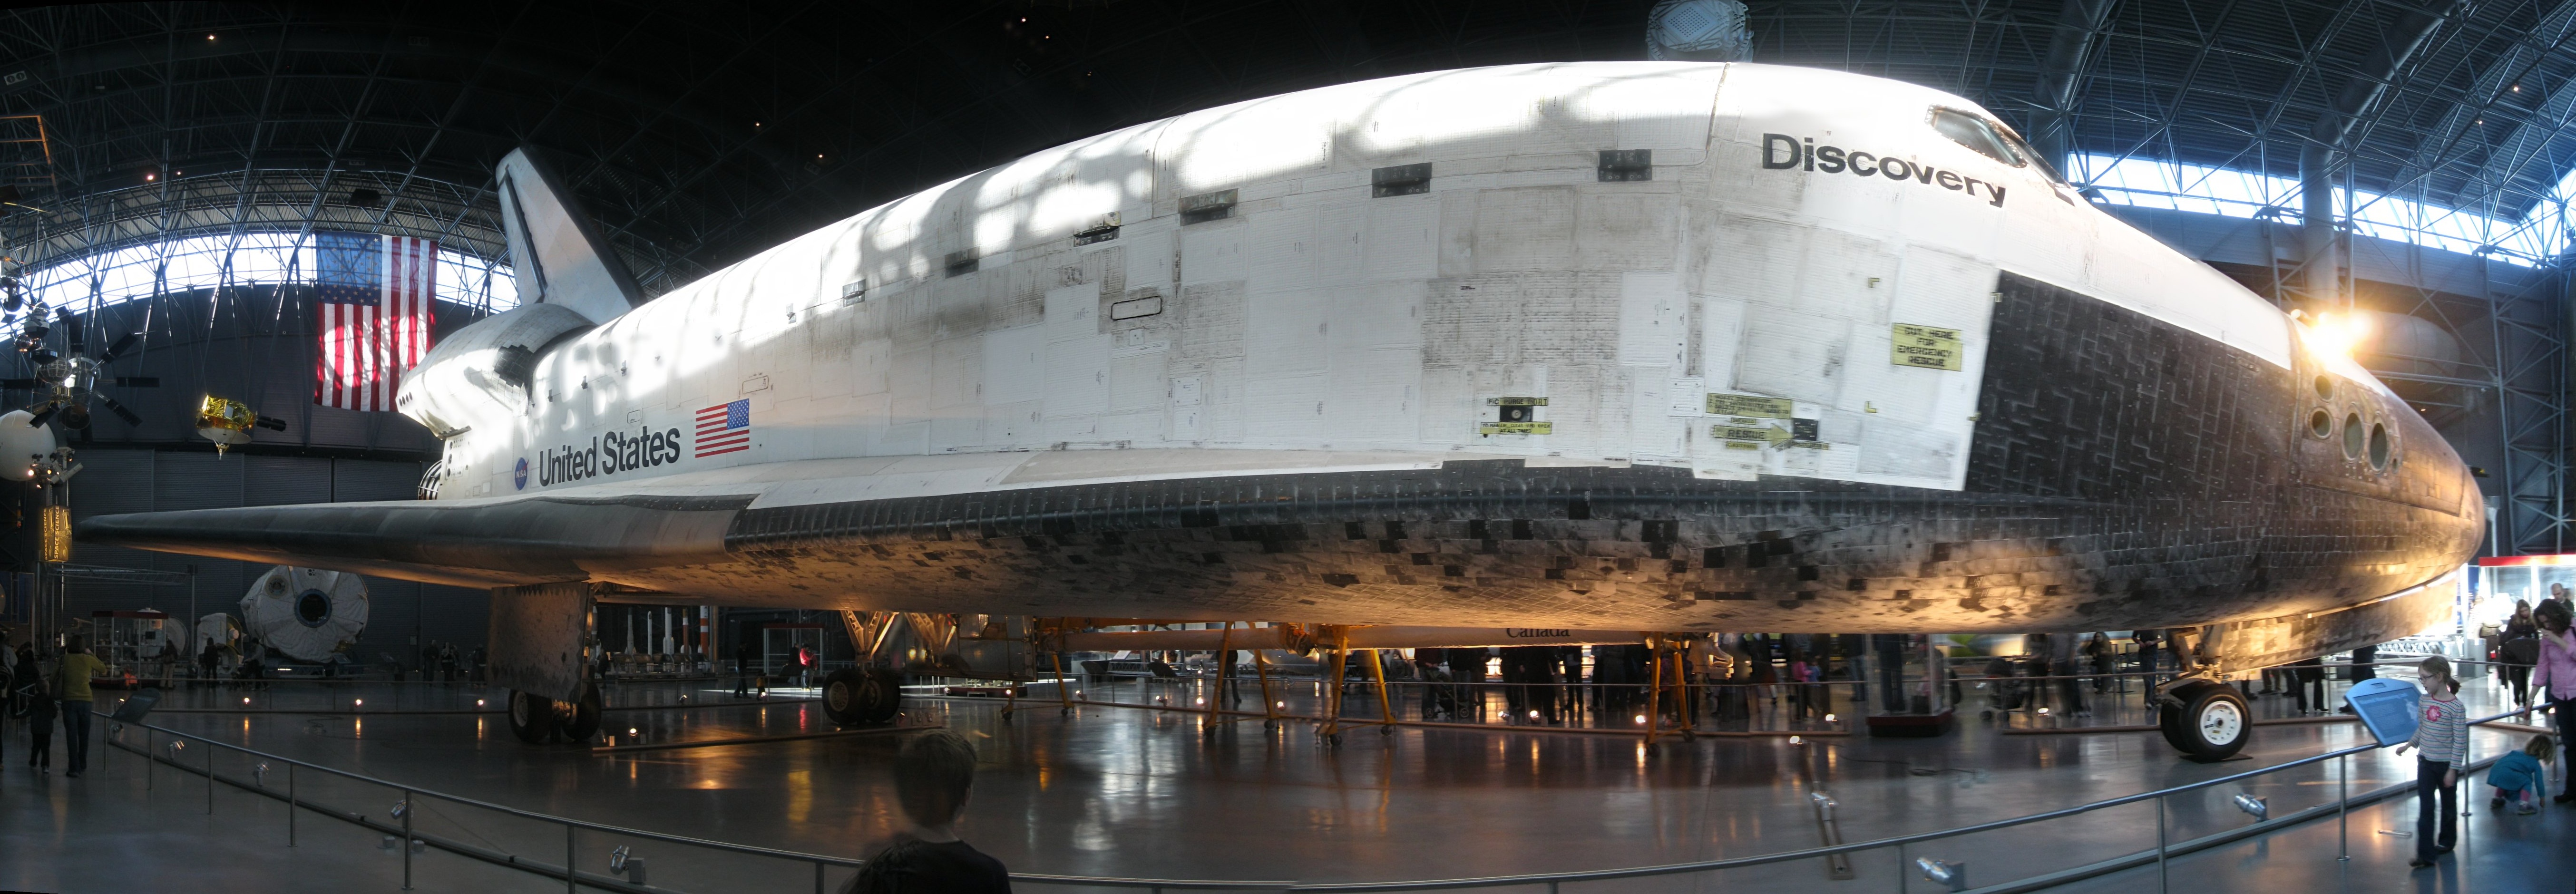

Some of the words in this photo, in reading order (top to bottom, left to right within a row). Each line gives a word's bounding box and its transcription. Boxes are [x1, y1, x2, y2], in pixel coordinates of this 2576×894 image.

[1762, 133, 2006, 208] Discovery
[1929, 330, 1953, 339] HERE
[1917, 338, 1934, 346] FOR
[1897, 345, 1952, 358] EMERGENCY
[1908, 356, 1945, 367] RESCUE
[539, 437, 597, 486] United
[602, 426, 680, 475] States
